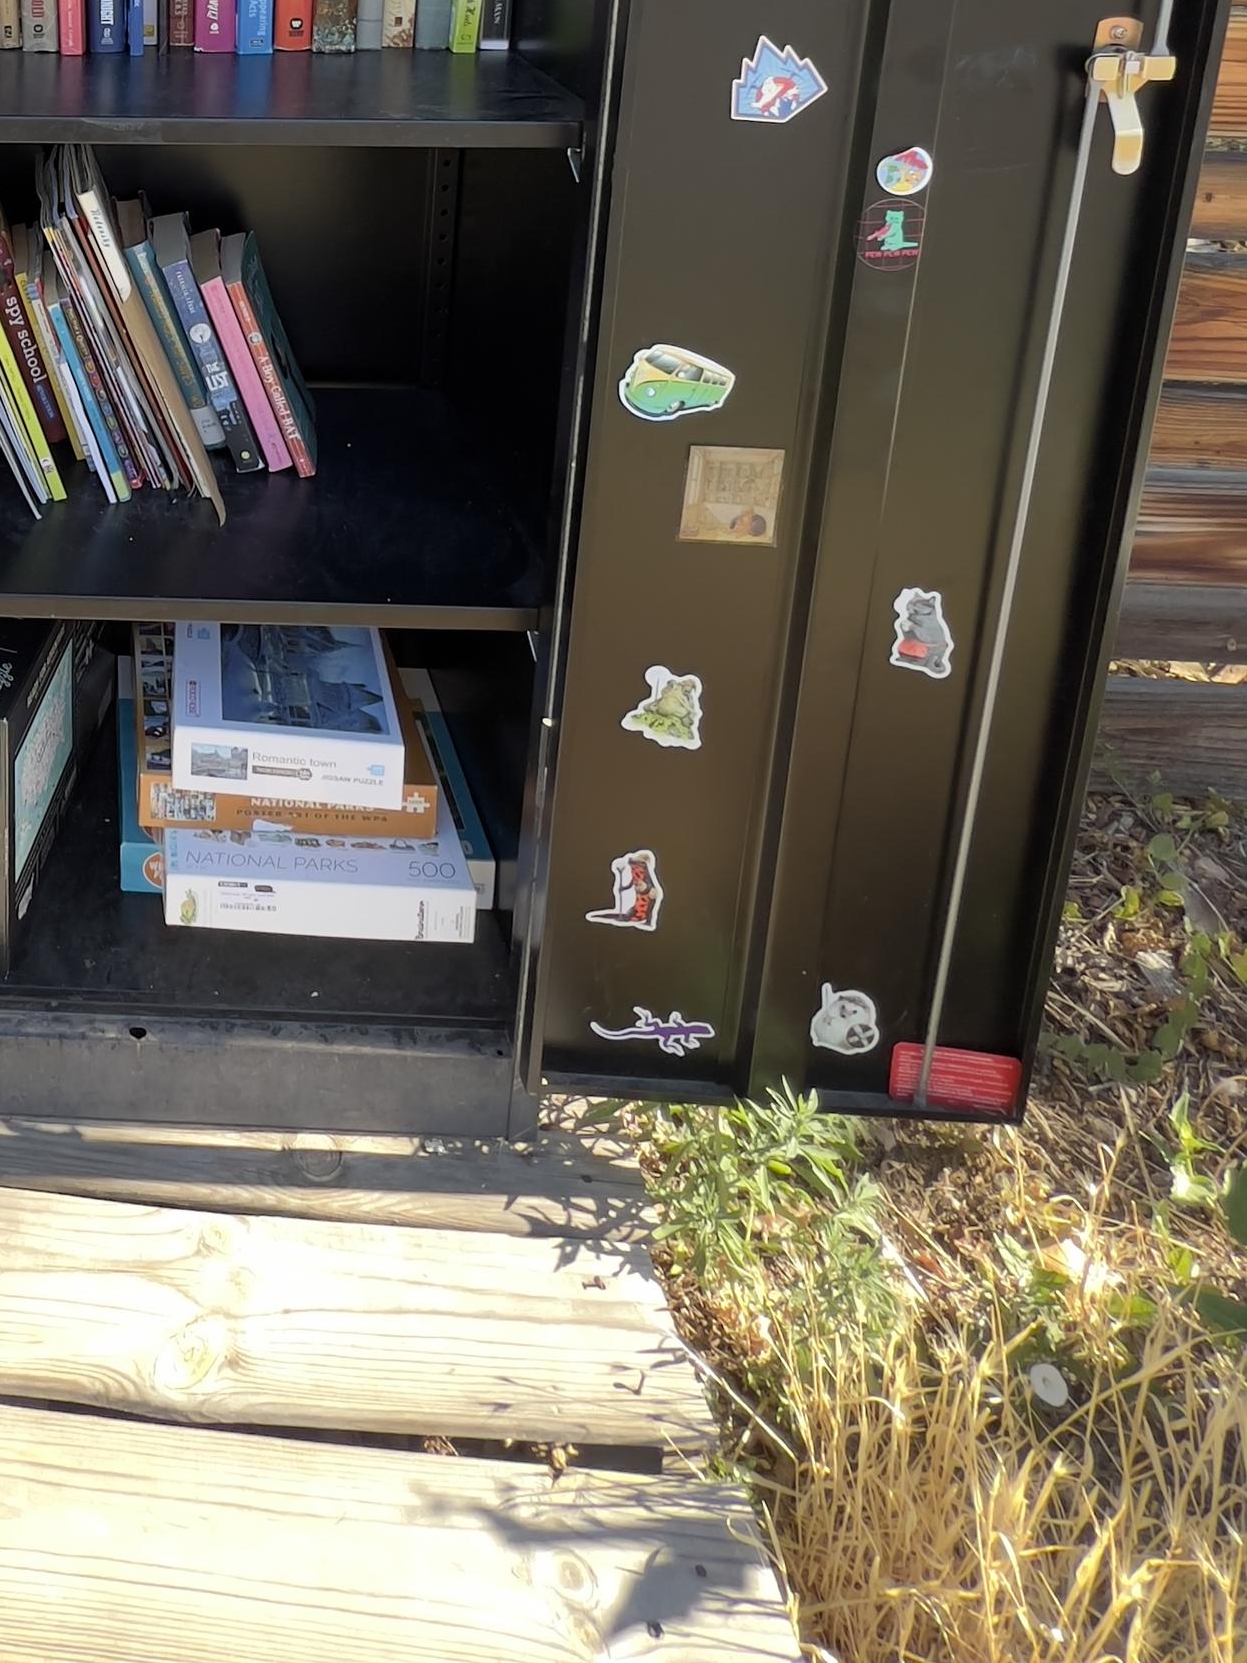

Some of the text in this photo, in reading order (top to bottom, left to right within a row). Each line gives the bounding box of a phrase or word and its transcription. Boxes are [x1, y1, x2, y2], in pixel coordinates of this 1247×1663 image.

[248, 0, 259, 18] Acts
[5, 295, 48, 383] spy school
[205, 372, 230, 391] LIST
[270, 385, 290, 415] Called
[252, 752, 337, 769] Romantic town
[250, 797, 318, 810] NATIONAL
[184, 849, 359, 873] NATIONAL PARKS
[408, 861, 456, 879] 500
